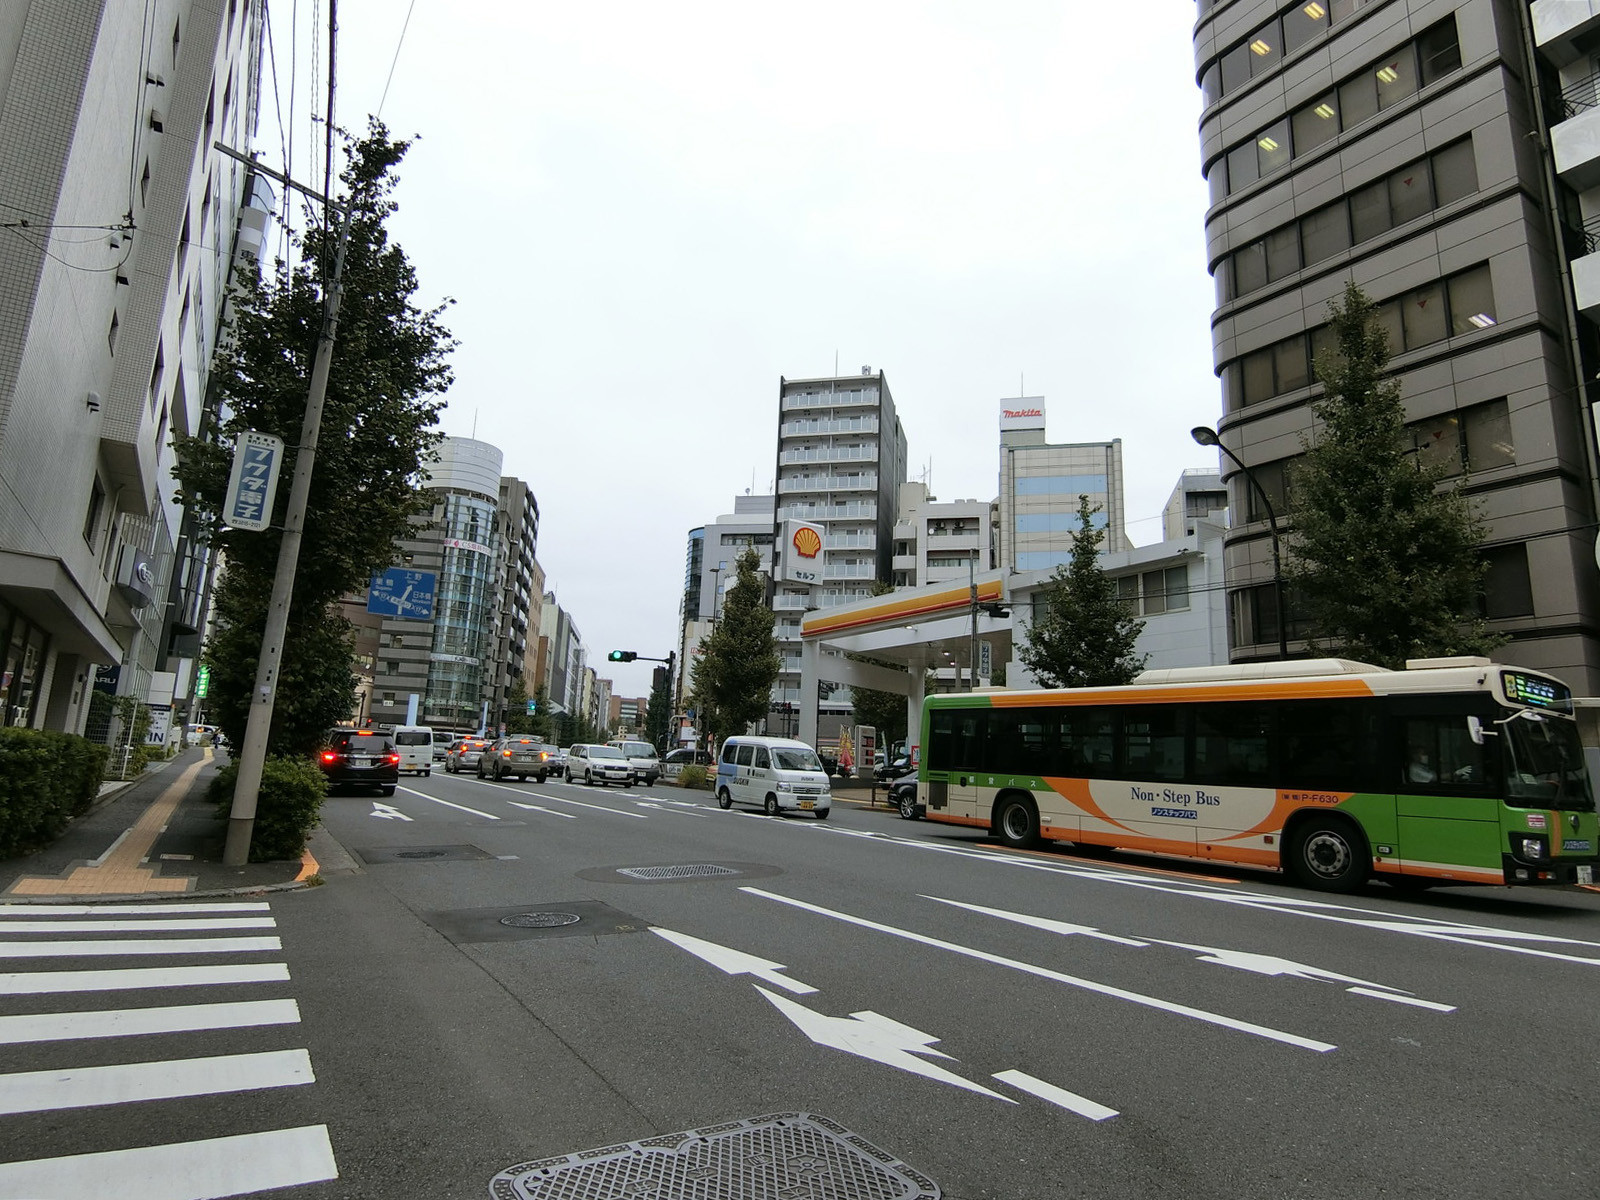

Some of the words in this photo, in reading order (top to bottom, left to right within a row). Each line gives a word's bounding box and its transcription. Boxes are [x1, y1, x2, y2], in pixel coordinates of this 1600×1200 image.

[237, 446, 271, 518] フクダ電子
[796, 570, 815, 580] セルフ
[1196, 791, 1220, 806] Bus
